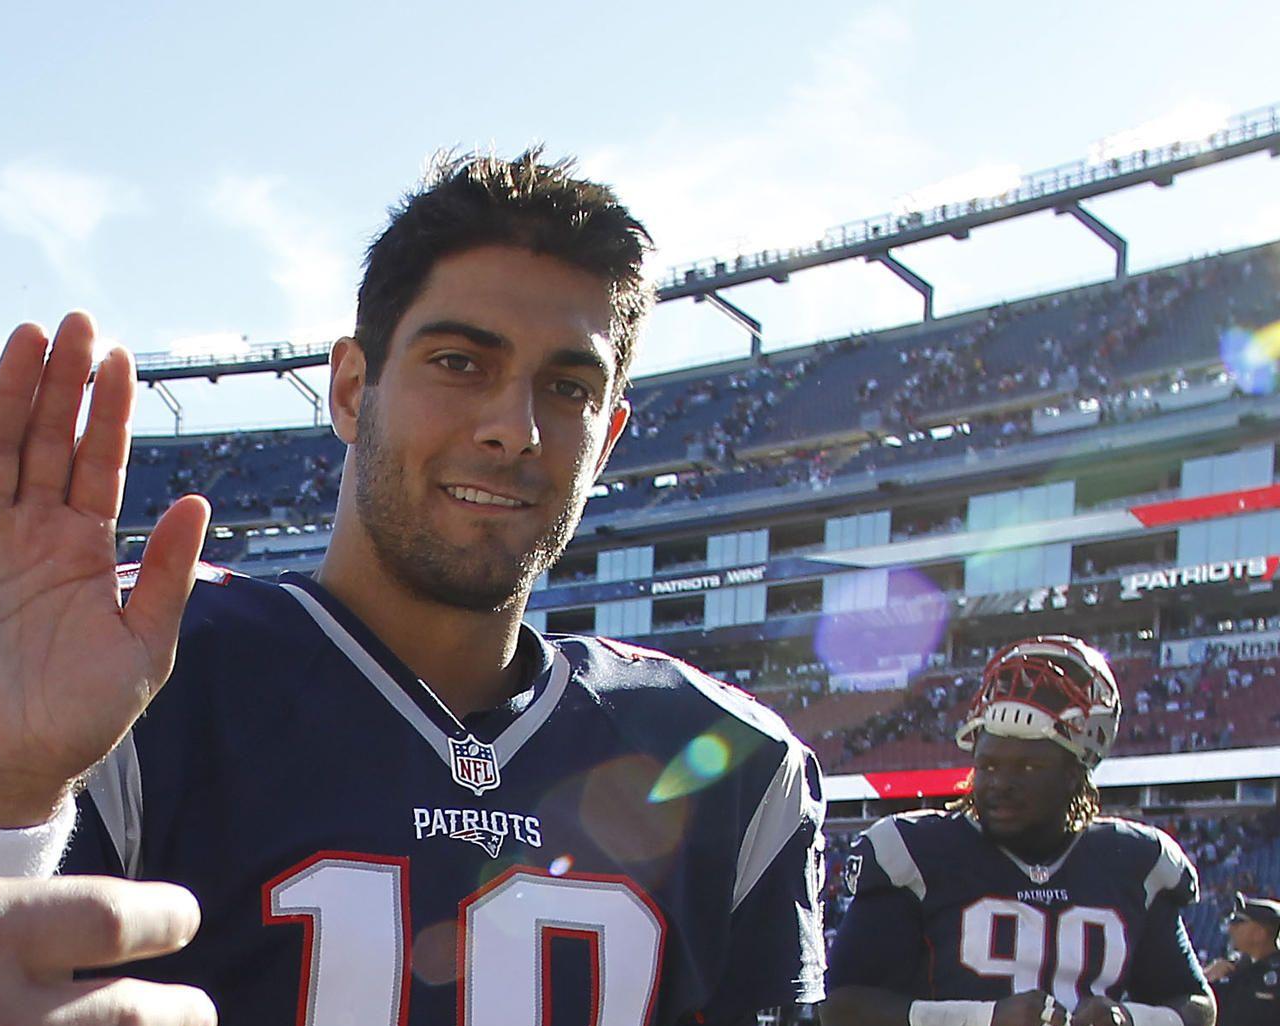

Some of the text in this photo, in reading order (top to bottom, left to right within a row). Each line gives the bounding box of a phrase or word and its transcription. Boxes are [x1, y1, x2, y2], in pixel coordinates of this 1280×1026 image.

[651, 574, 721, 595] PATRIOTS
[1129, 556, 1268, 593] PATRIOTS
[459, 758, 494, 784] NFL
[413, 808, 542, 848] PATRIOTS
[1016, 888, 1069, 901] PATRIOTS
[959, 893, 1129, 1012] 90
